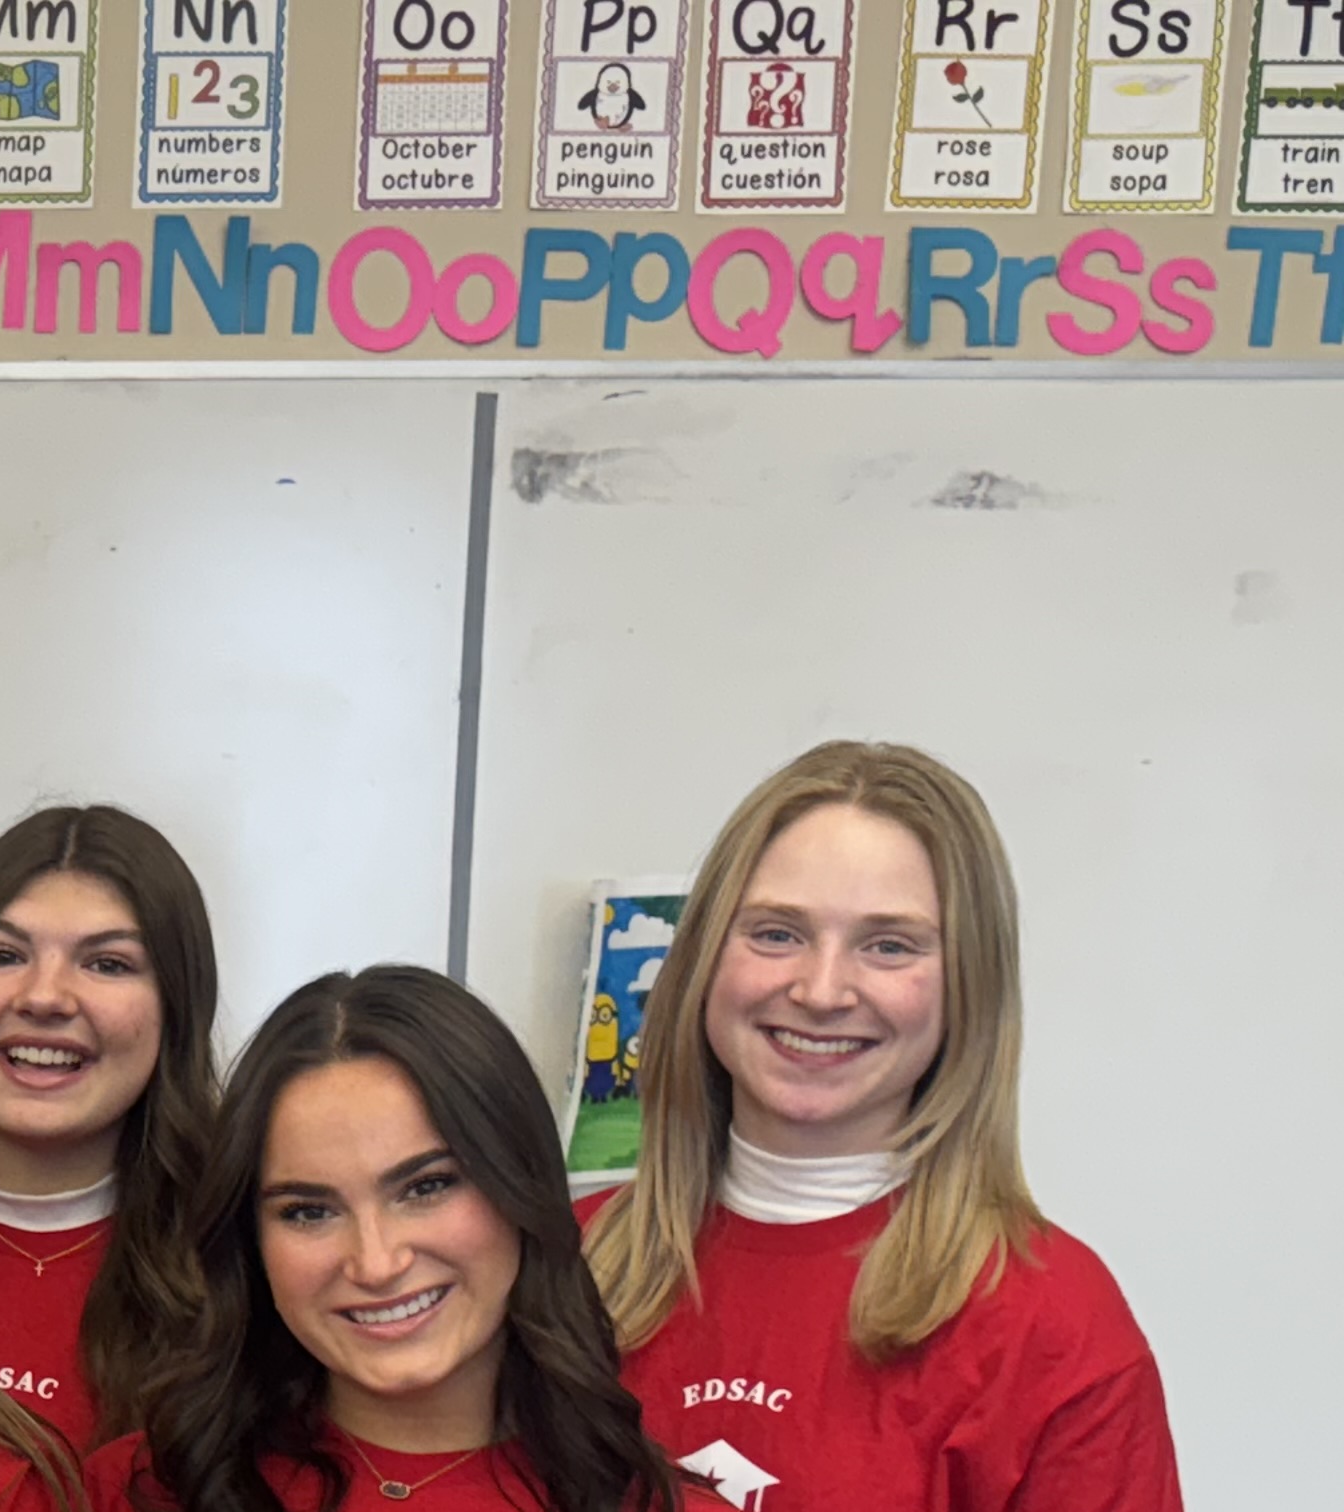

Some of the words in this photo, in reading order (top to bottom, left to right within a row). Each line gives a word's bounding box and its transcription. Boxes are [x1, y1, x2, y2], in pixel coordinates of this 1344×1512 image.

[174, 0, 257, 45] Nn
[393, 0, 475, 51] Oo
[581, 0, 657, 54] Pp
[732, 0, 825, 56] Qq
[935, 0, 1019, 52] Rr
[1109, 0, 1191, 58] Ss
[159, 133, 260, 153] numbers
[381, 138, 477, 160] October
[561, 137, 653, 164] penguin
[720, 139, 825, 165] question
[938, 140, 991, 156] rose
[1113, 144, 1168, 163] soup
[1282, 143, 1339, 163] train
[156, 164, 260, 185] números
[382, 169, 473, 190] octubre
[721, 169, 820, 190] cuestión
[934, 171, 990, 188] rosa
[1110, 175, 1167, 195] sopa
[1283, 174, 1333, 194] tren
[152, 217, 317, 333] Nn
[328, 228, 518, 352] Oo
[519, 230, 688, 348] Pp
[688, 229, 901, 357] Qq
[912, 230, 1057, 345] Rr
[1048, 231, 1215, 354] Ss
[683, 1378, 792, 1412] EDSAC
